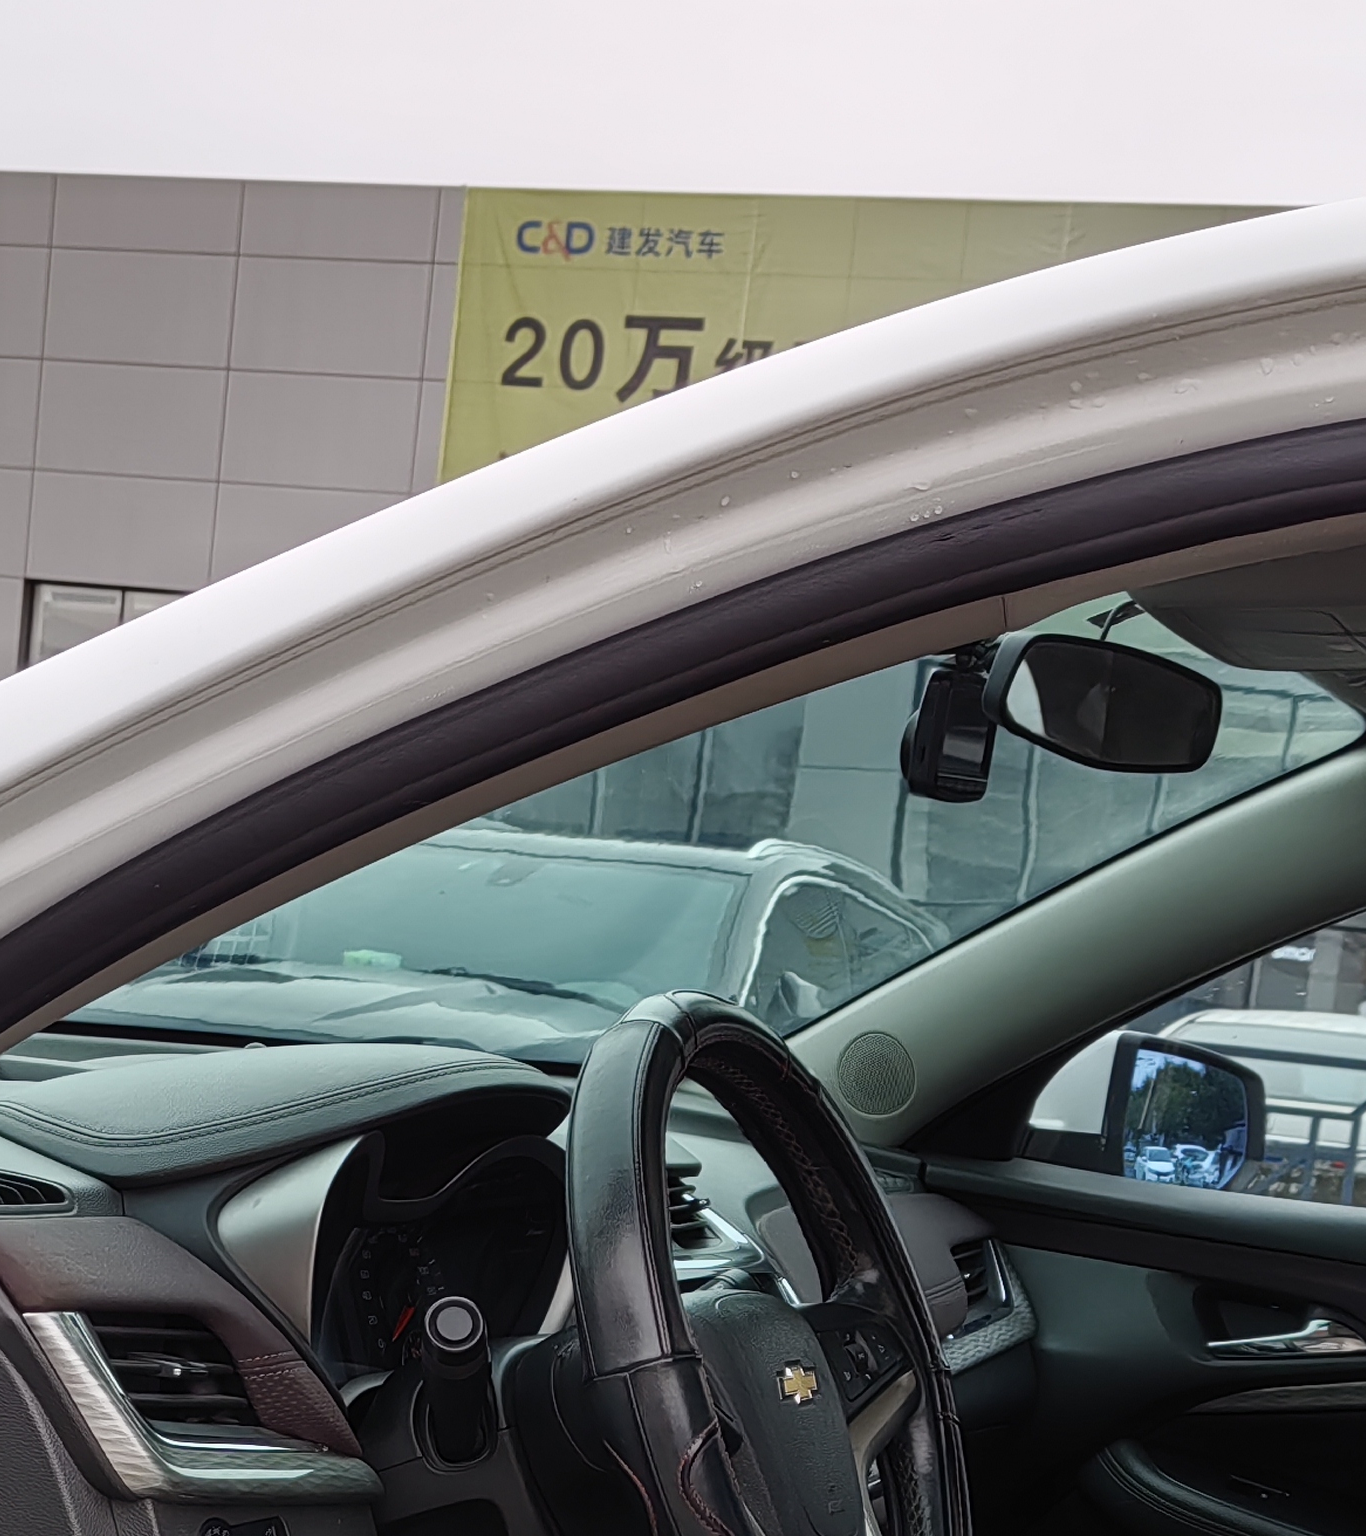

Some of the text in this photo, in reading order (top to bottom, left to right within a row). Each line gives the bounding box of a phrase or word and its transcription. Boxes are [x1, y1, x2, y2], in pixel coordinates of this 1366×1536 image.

[516, 220, 726, 262] C&D 建发汽车
